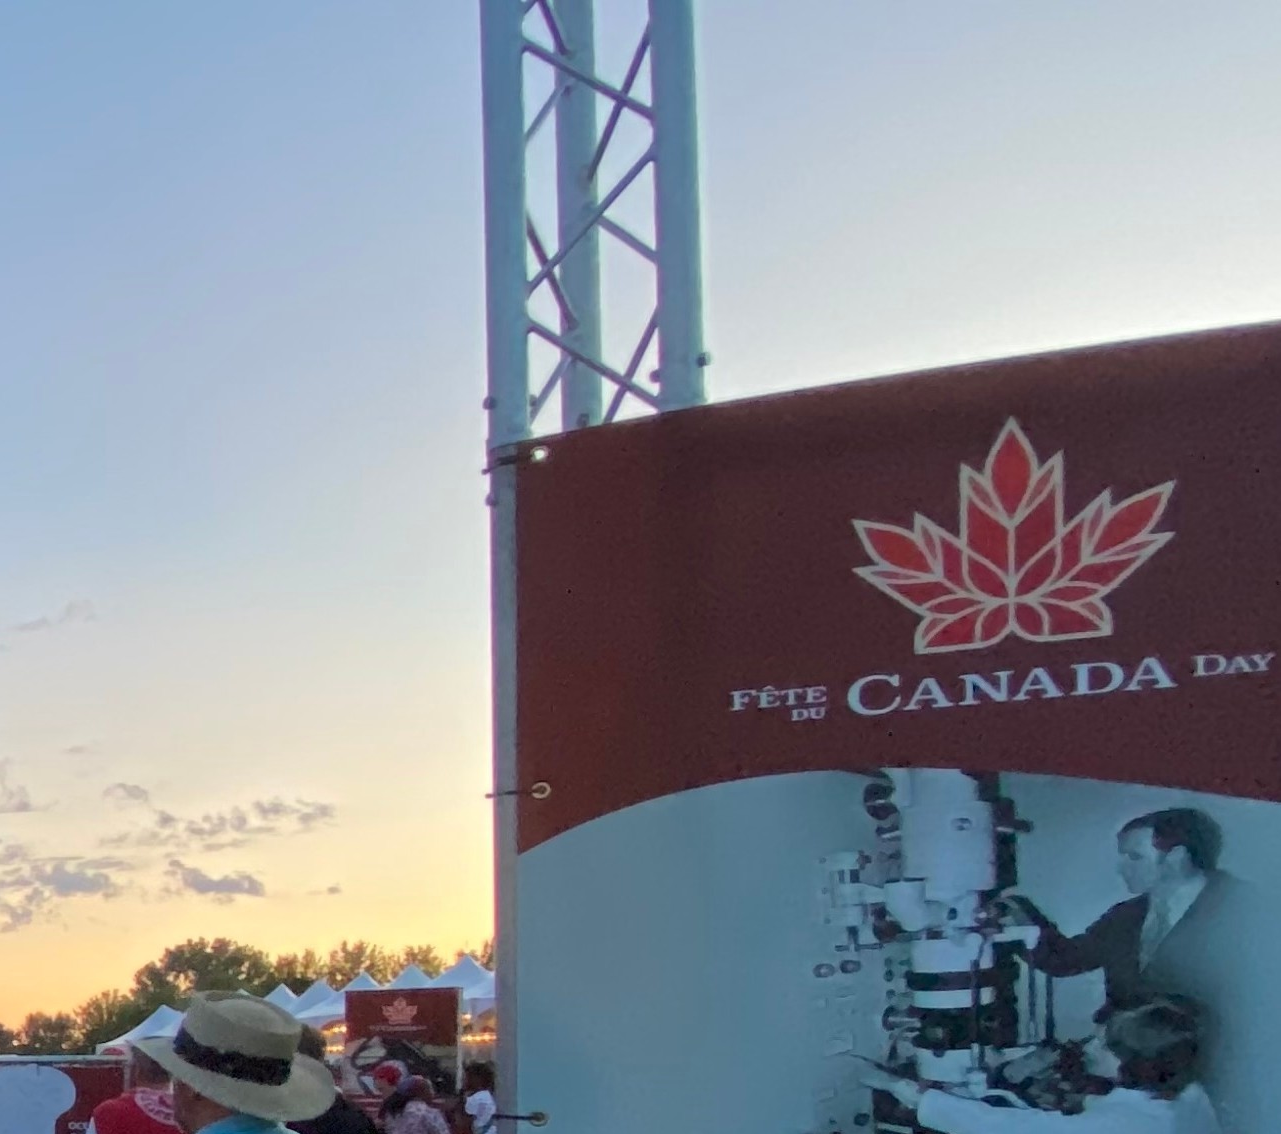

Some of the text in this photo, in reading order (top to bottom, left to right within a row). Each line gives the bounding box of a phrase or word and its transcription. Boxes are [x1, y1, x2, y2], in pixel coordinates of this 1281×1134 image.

[730, 652, 1275, 722] FÊTE DU CANADA DAY
